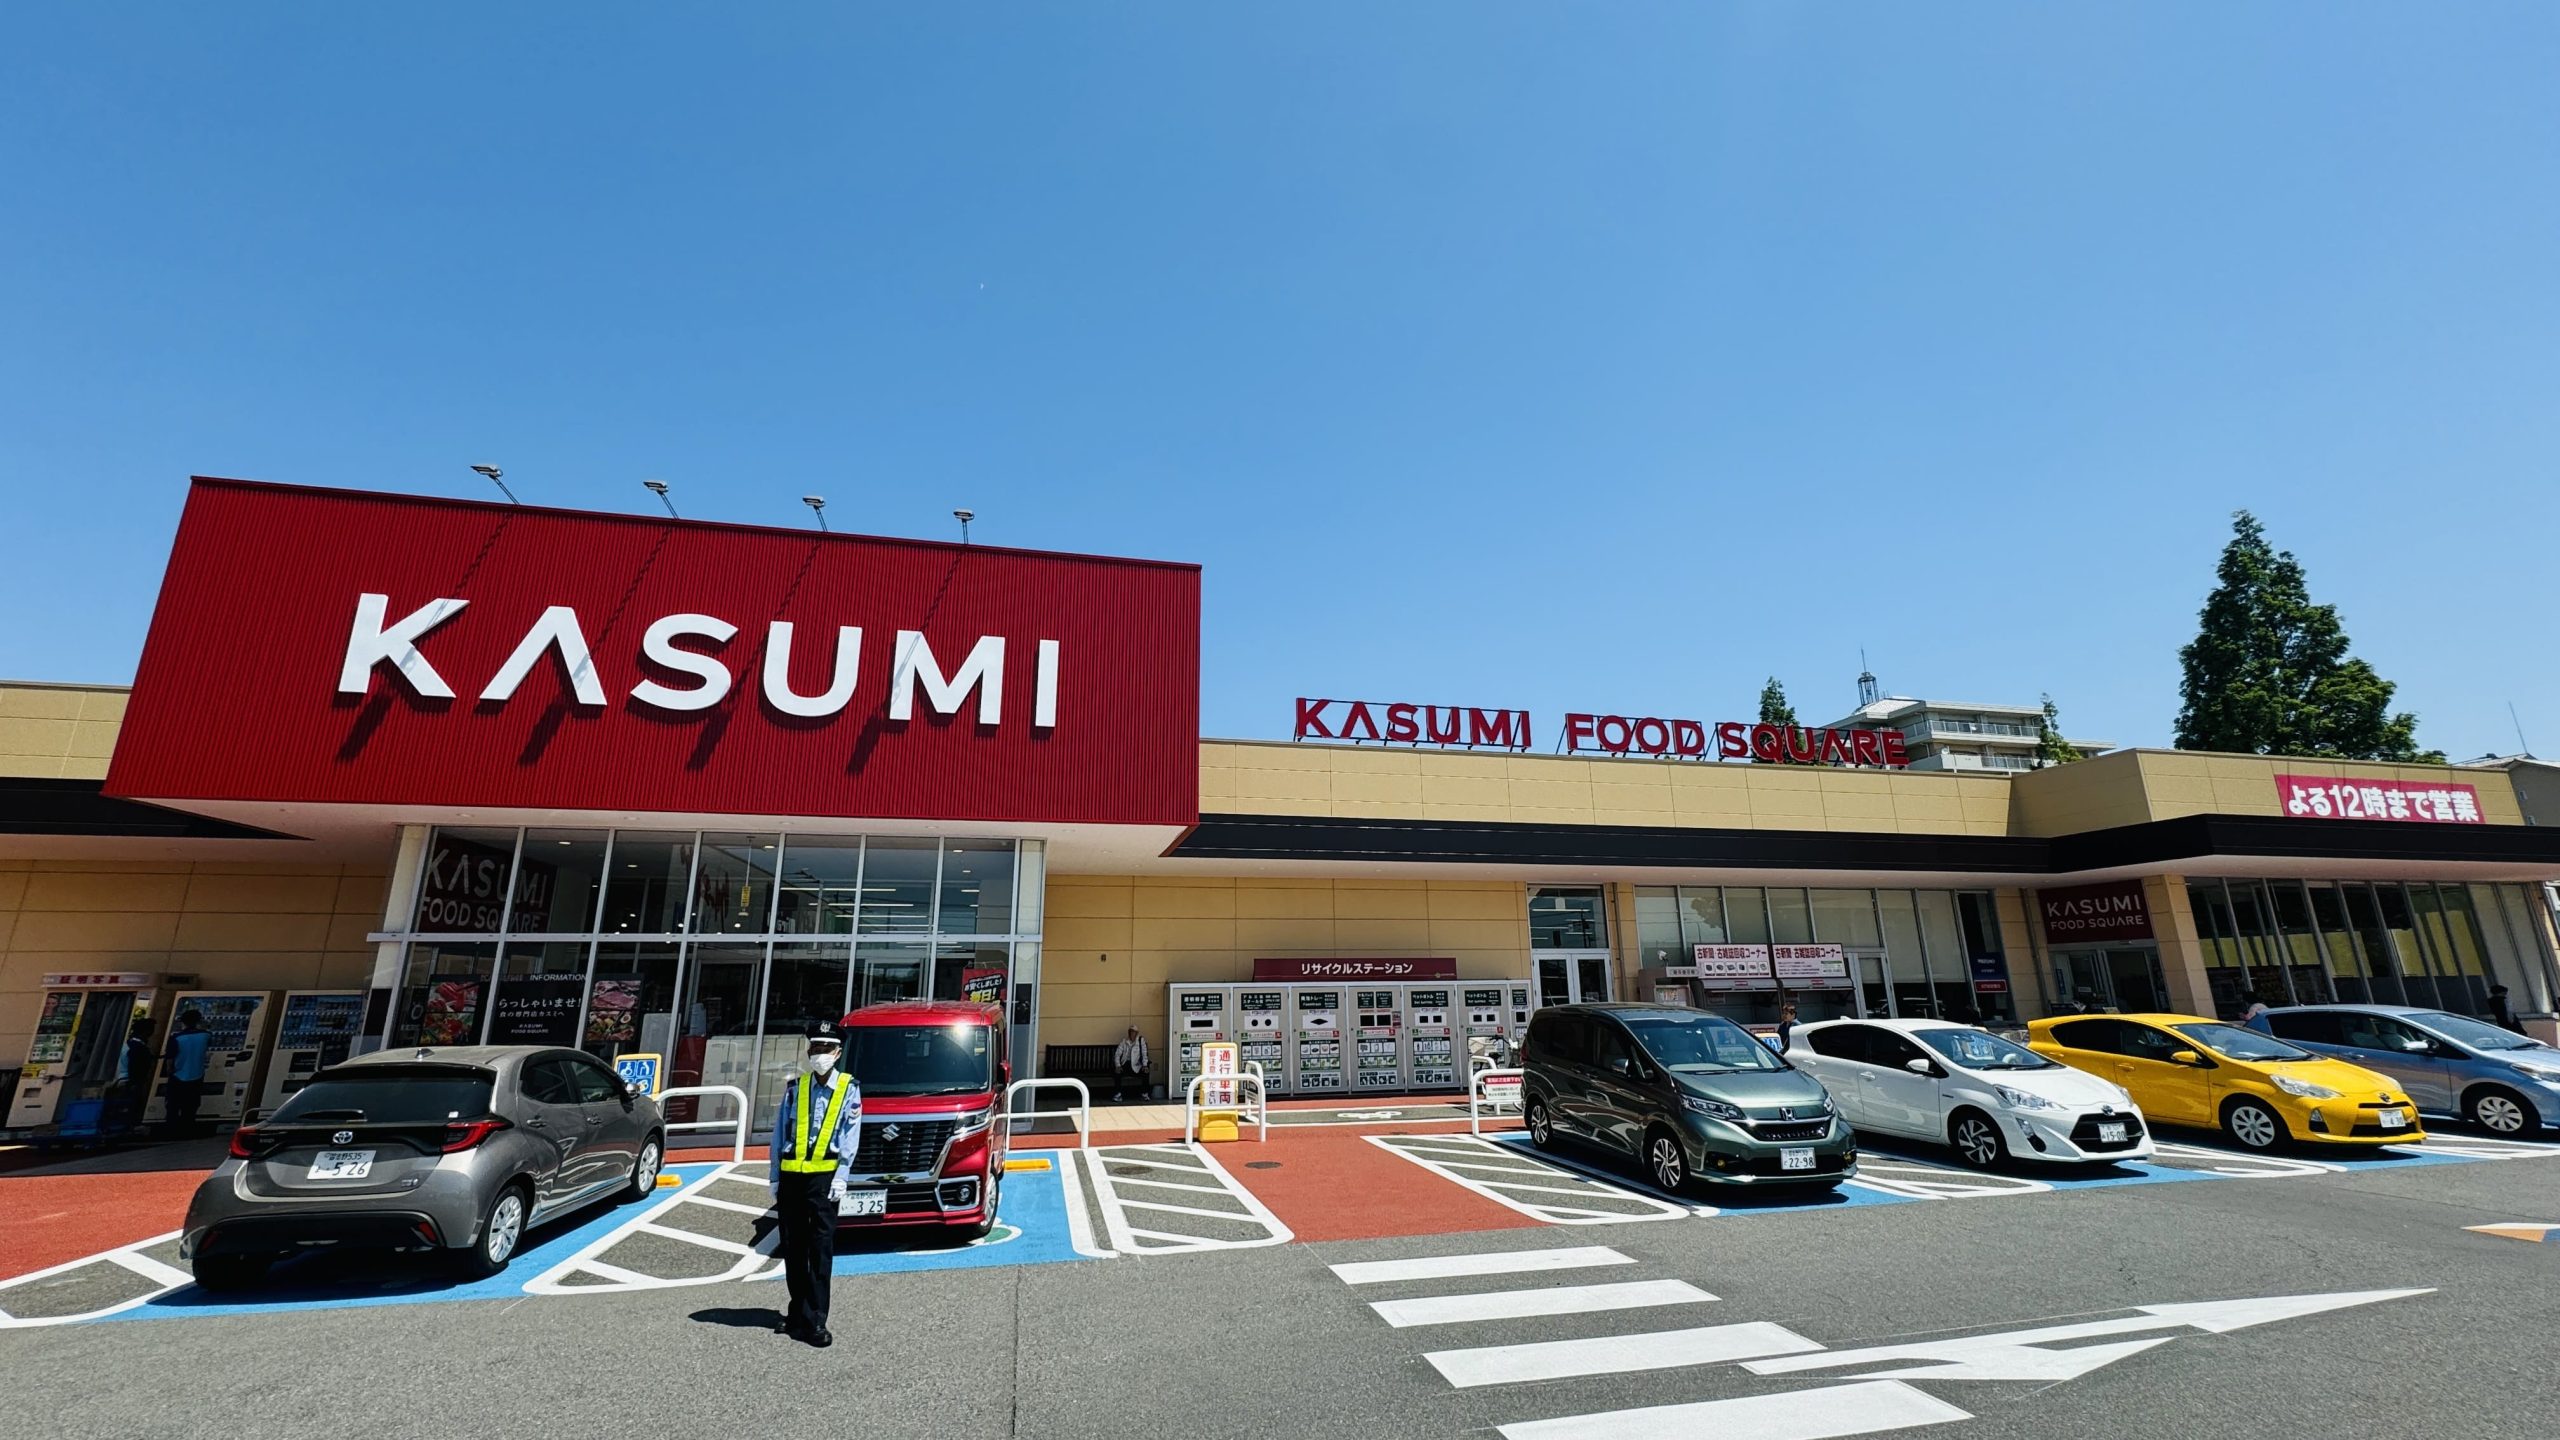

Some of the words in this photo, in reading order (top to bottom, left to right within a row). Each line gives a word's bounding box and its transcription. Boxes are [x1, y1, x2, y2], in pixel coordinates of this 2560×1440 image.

[338, 593, 1060, 729] KASUMI
[1296, 698, 1532, 748] KASUMI
[1565, 713, 1706, 756] FOOD
[1718, 722, 1910, 766] SQUARE
[2288, 785, 2480, 822] よる12時まで営業
[2047, 894, 2141, 917] KASUMI
[2050, 920, 2085, 930] FOOD
[2088, 915, 2144, 928] SQUARE
[1301, 963, 1413, 975] リサイクルステーション
[499, 998, 582, 1008] らっしゃいませ!
[1789, 1156, 1814, 1168] 22-98
